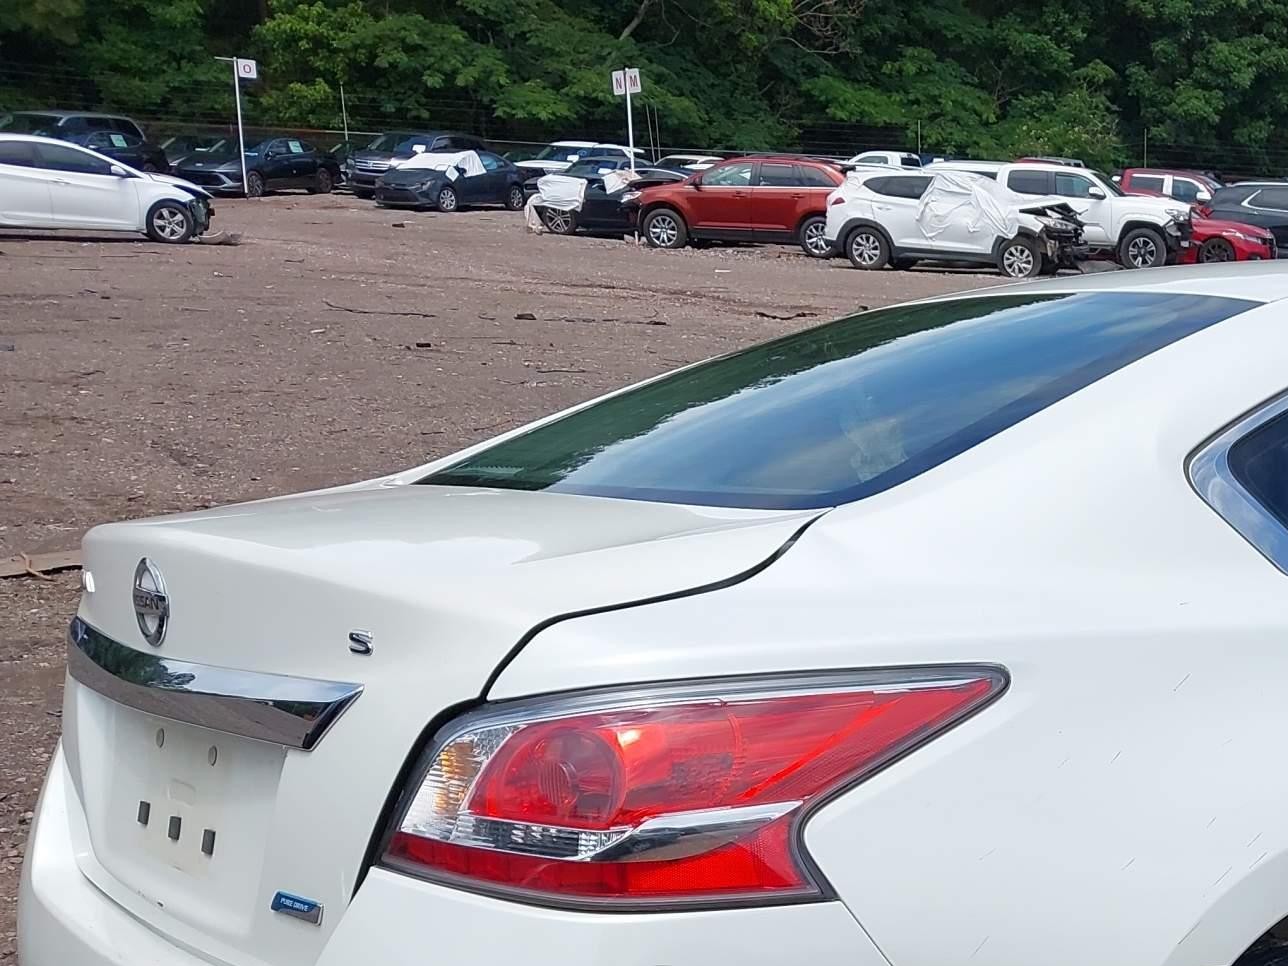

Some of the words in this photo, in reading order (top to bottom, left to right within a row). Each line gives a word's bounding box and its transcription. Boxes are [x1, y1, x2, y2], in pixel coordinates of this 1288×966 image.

[616, 77, 622, 90] N
[630, 74, 639, 88] M
[348, 629, 374, 656] S
[293, 902, 309, 912] DRIVE
